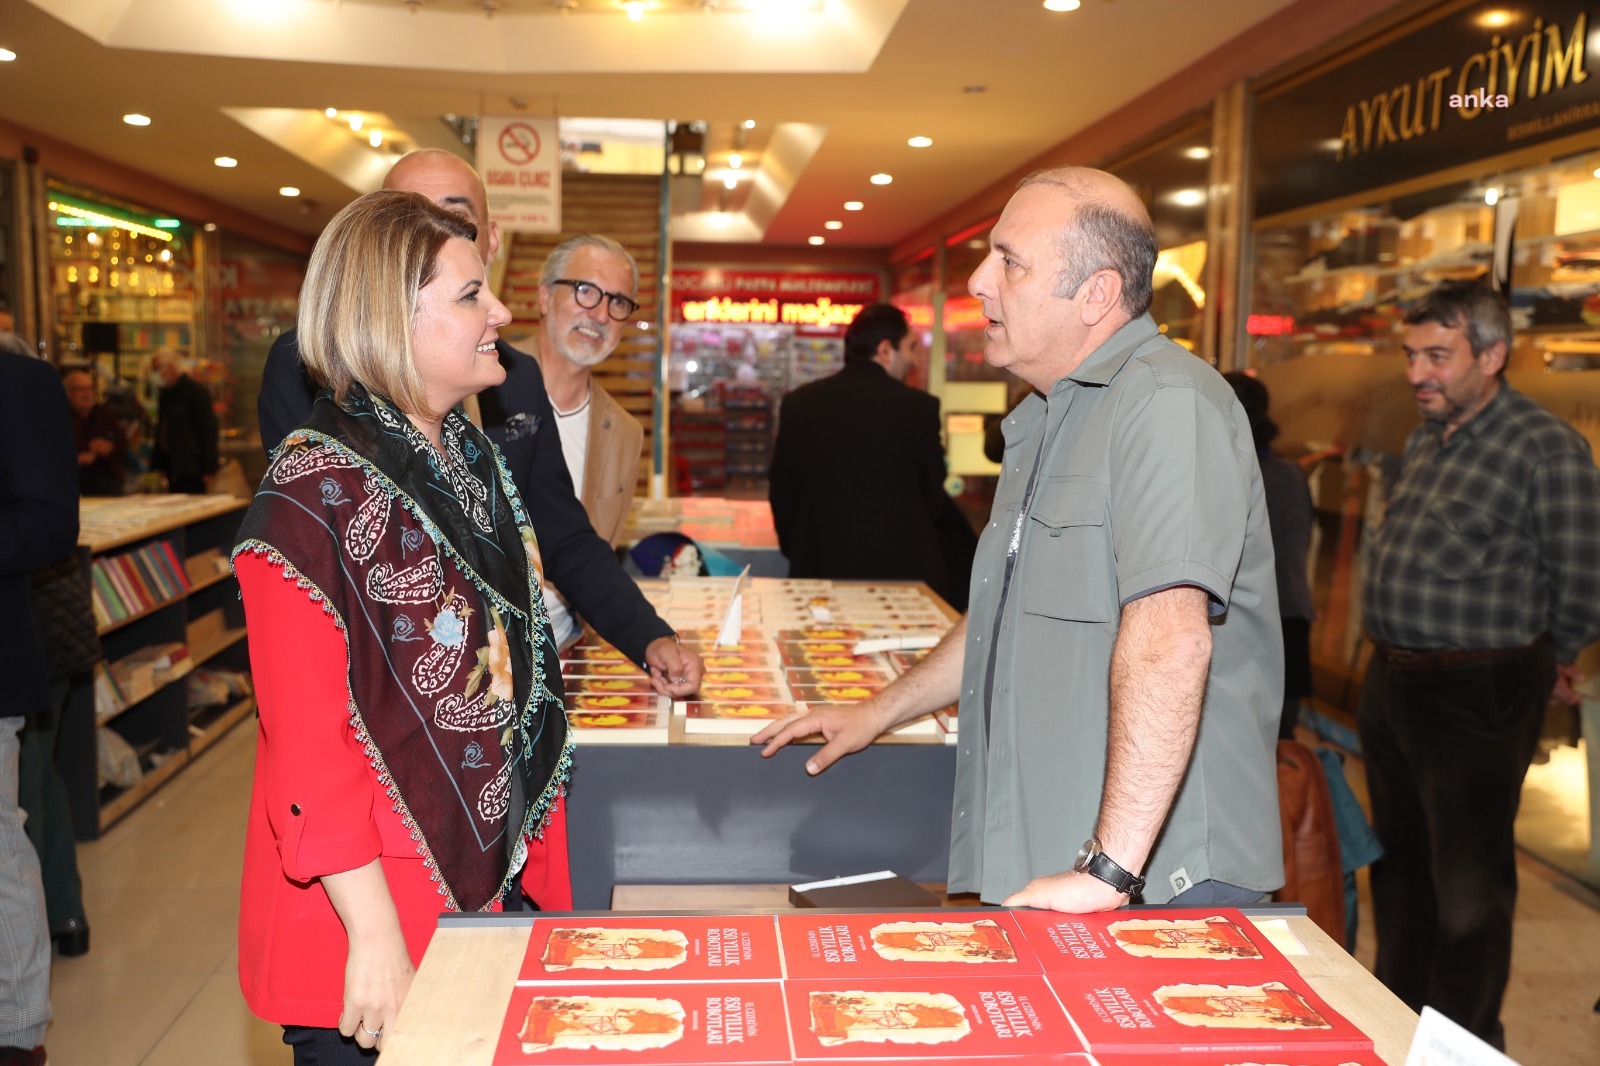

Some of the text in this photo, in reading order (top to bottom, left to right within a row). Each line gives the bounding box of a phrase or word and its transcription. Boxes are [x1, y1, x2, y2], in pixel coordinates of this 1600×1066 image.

[1335, 12, 1588, 162] AYKUT GİYİM
[707, 928, 722, 966] ROBOTLARI
[723, 928, 740, 966] 850 YILLIK
[818, 925, 841, 962] 850 YILLIK
[835, 925, 857, 962] ROBOTLARI
[1055, 922, 1091, 959] 850 YILLIK
[1071, 922, 1107, 958] ROBOTLARI
[706, 997, 723, 1044] ROBOTLARI
[724, 996, 744, 1044] 850 YILLIK
[978, 991, 1013, 1038] ROBOTLARI
[995, 991, 1033, 1038] 850 YILLIK
[1093, 987, 1137, 1028] 850 YILLIK
[1111, 987, 1155, 1028] ROBOTLARI
